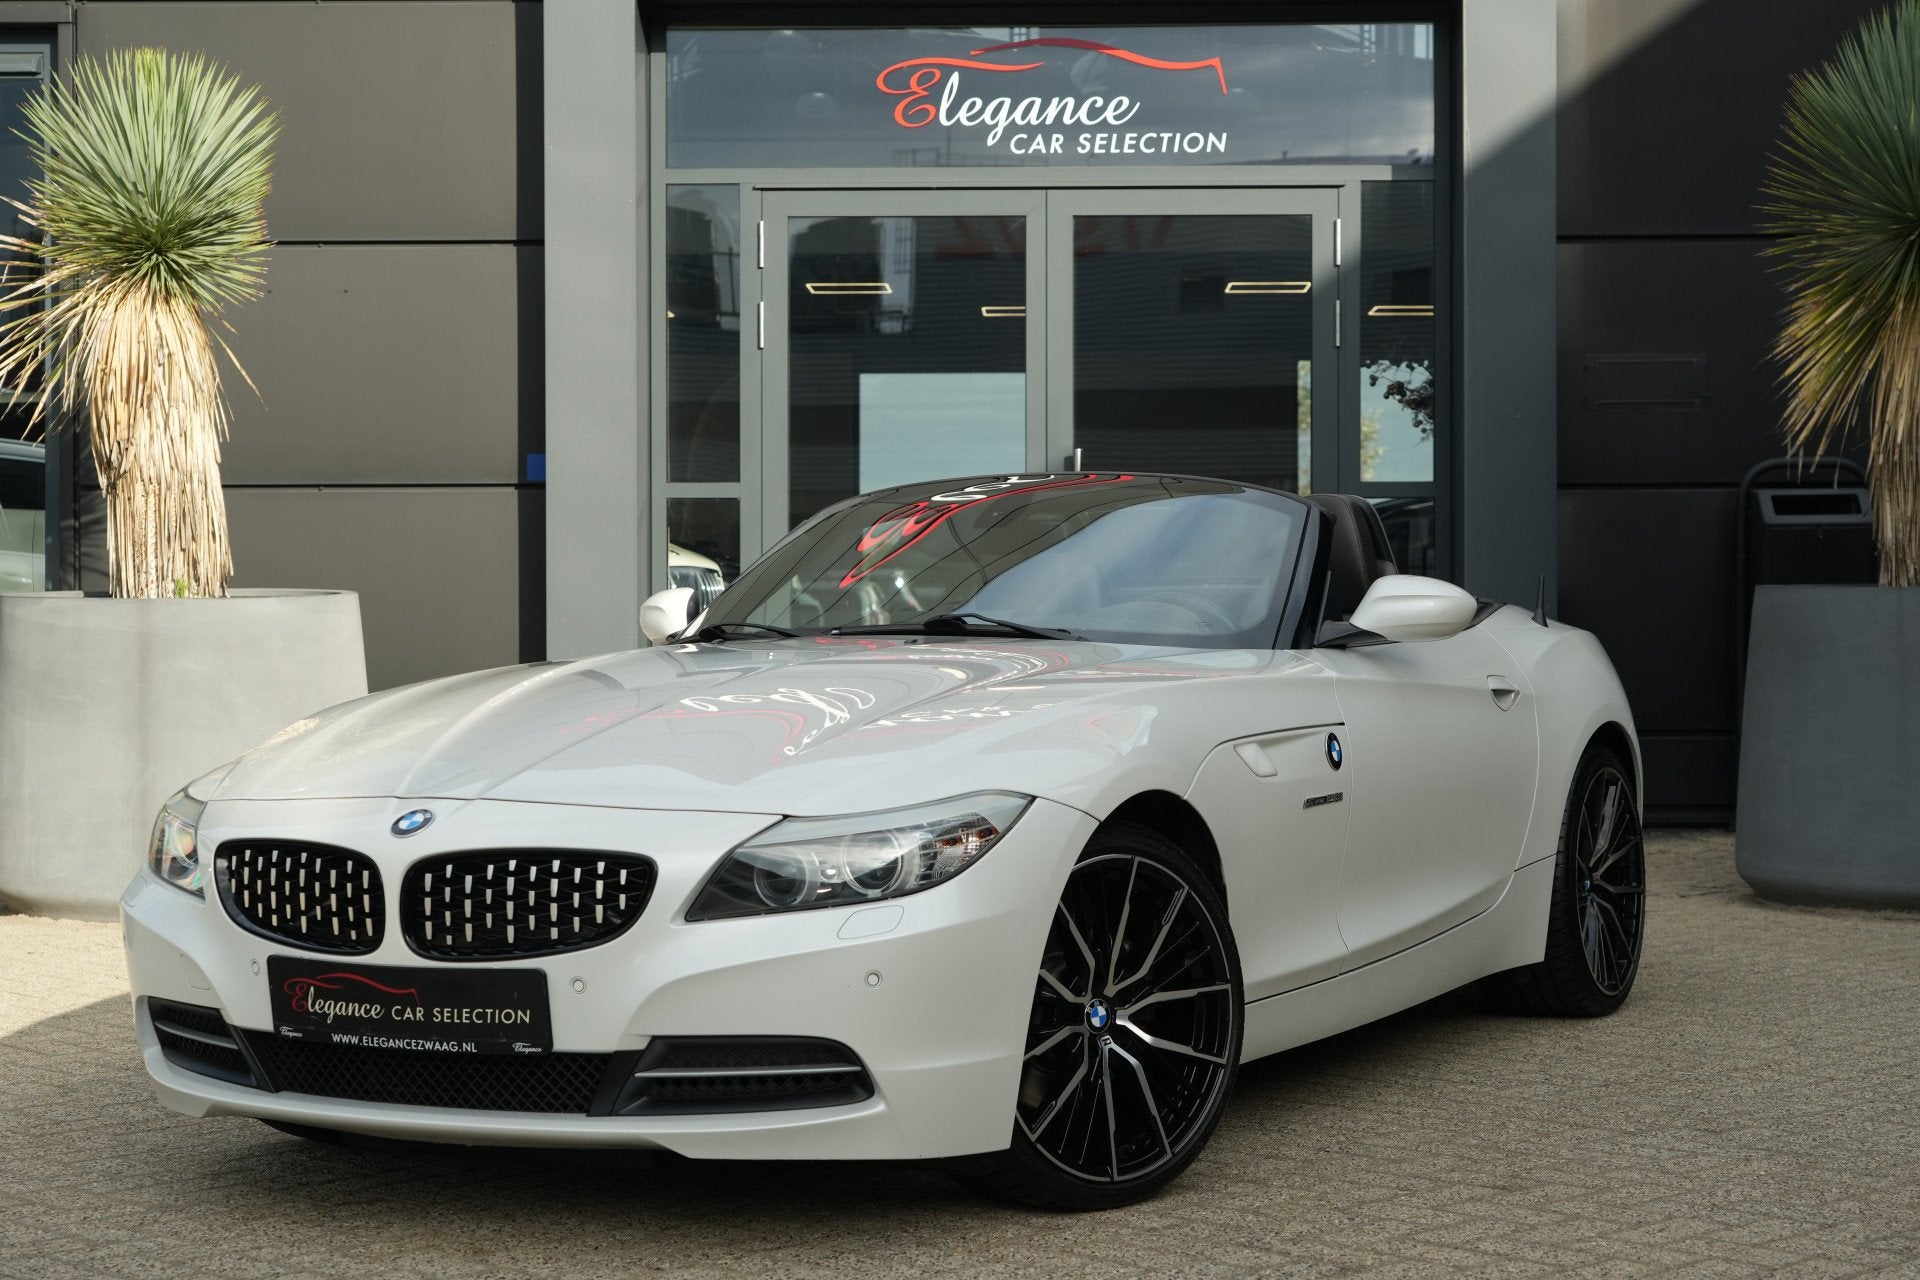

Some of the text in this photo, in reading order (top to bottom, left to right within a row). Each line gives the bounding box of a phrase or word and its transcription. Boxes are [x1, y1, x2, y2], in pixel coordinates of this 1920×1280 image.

[876, 57, 1140, 147] Elegance
[1009, 132, 1228, 154] CAR SELECTION
[284, 977, 531, 1025] Elegance CAR SELECTION
[331, 1033, 478, 1053] WWW.ELEGANCEZWAAG.NL
